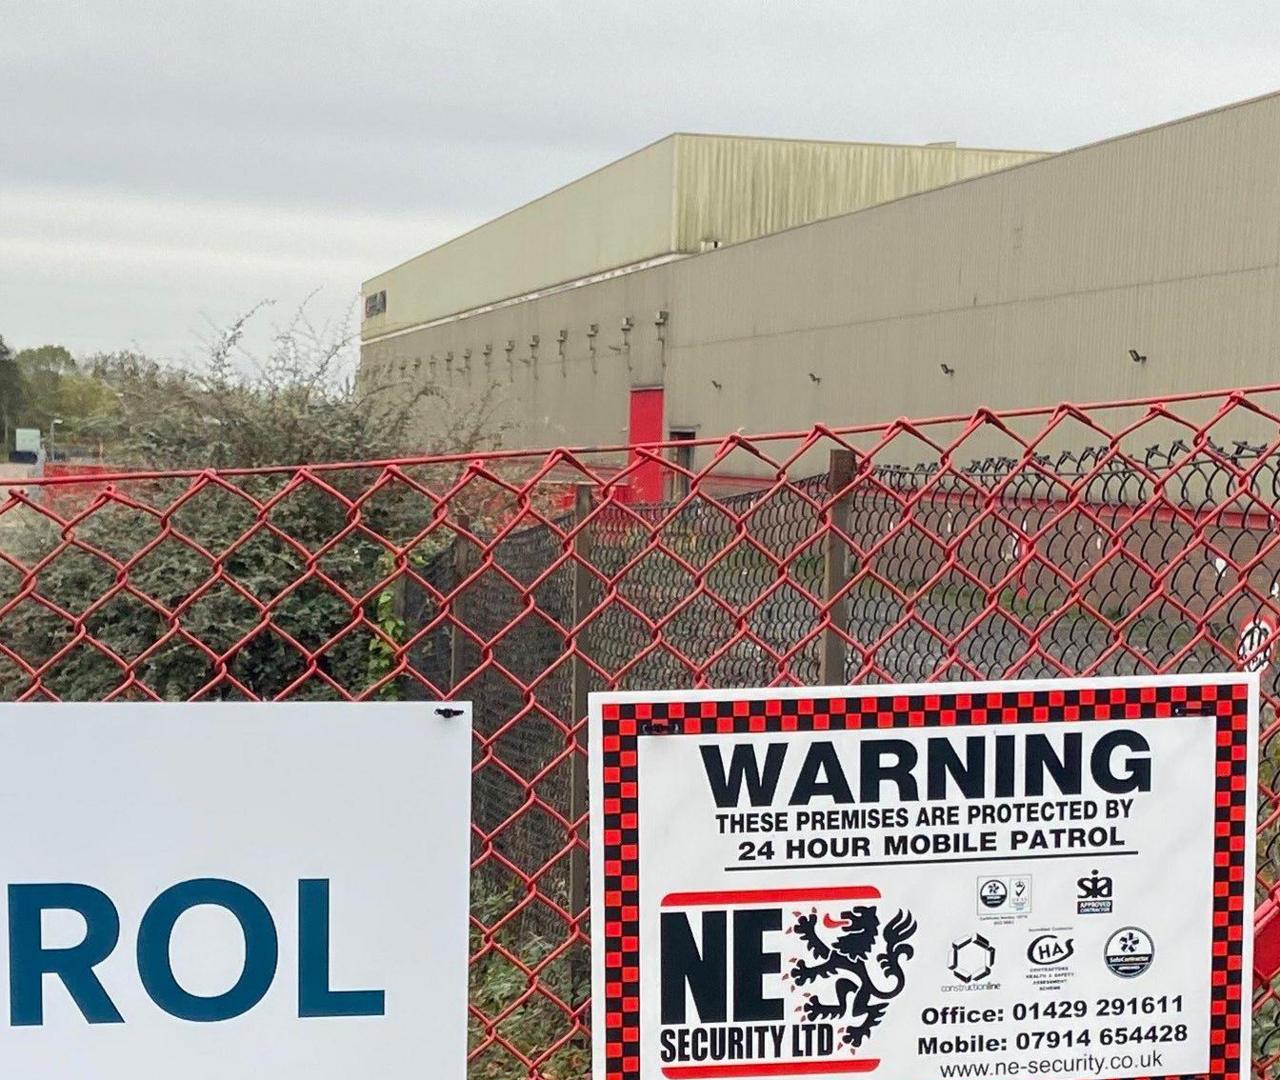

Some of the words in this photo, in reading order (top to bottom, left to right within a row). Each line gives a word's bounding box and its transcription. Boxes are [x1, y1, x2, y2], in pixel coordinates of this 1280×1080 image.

[698, 729, 1152, 809] WARNING
[715, 811, 789, 834] THESE
[796, 807, 909, 831] PREMISES
[915, 805, 960, 827] ARE
[967, 800, 1098, 825] PROTECTED
[1105, 798, 1134, 819] BY
[738, 840, 775, 861] 24
[786, 836, 871, 860] HOUR
[884, 831, 997, 856] MOBILE
[1010, 826, 1125, 851] PATROL
[1077, 869, 1113, 899] sia
[1027, 934, 1074, 966] CHAS
[660, 907, 785, 1026] NE
[941, 981, 1001, 993] constructionline
[921, 1006, 1004, 1025] Office:
[1012, 1000, 1088, 1021] 01429
[1096, 994, 1182, 1017] 291611
[660, 1024, 786, 1063] SECURITY
[791, 1023, 834, 1058] LTD
[918, 1034, 1007, 1055] Mobile:
[1016, 1029, 1091, 1050] 07914
[1099, 1024, 1188, 1046] 654428
[940, 1050, 1162, 1078] www.ne-security.co.uk
